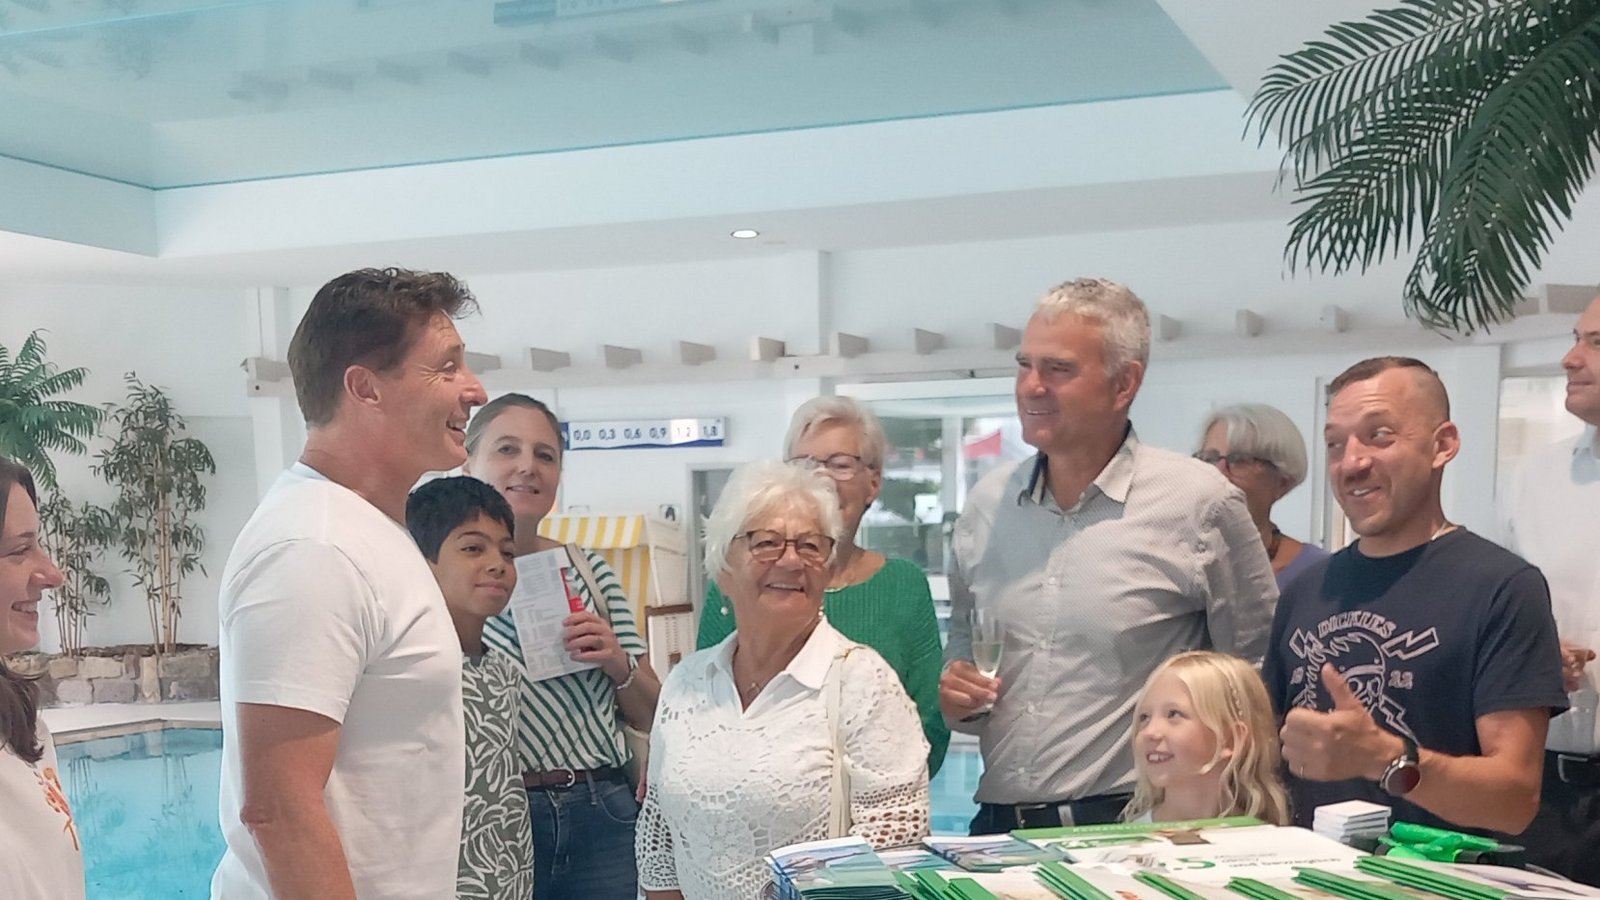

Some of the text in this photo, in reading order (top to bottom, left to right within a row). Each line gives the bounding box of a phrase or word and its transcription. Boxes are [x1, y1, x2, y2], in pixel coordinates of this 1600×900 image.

[573, 429, 591, 442] 0,0
[598, 428, 616, 441] 0,3
[623, 427, 641, 440] 0,6
[648, 426, 667, 440] 0,9
[676, 426, 691, 438] 12
[1317, 610, 1397, 639] DICKIES
